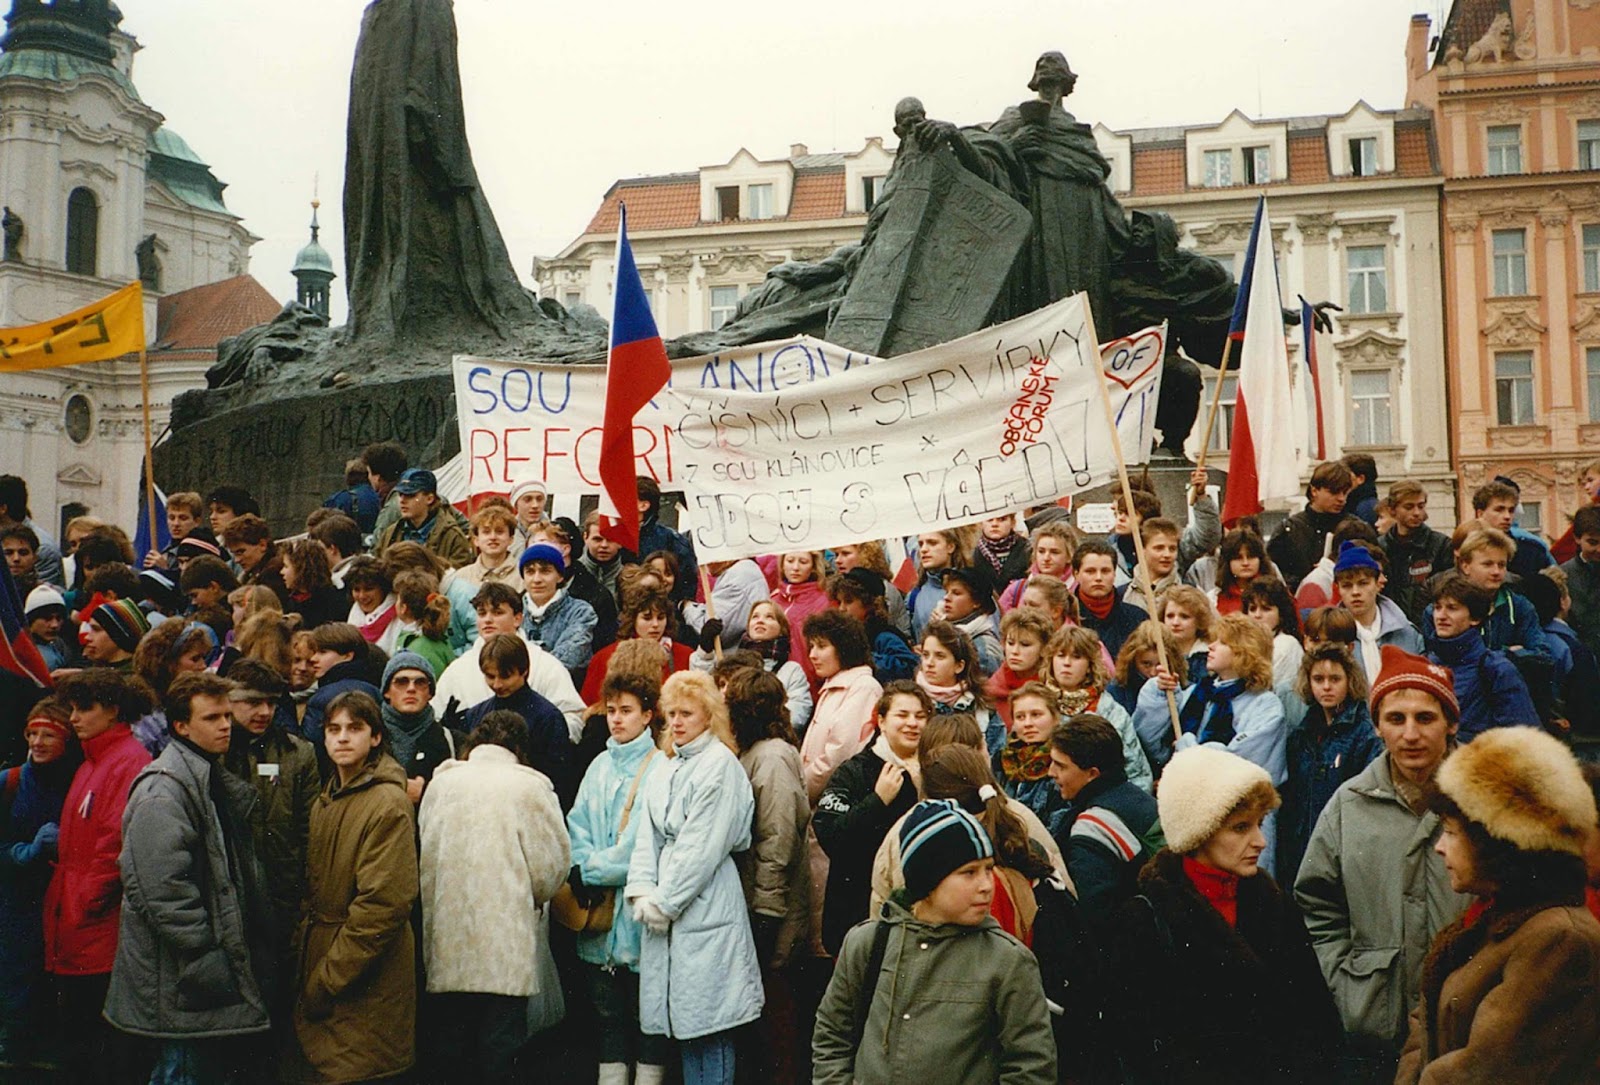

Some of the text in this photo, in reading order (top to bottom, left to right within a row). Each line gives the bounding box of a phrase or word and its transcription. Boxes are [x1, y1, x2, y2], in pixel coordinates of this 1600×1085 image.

[1112, 346, 1150, 371] OF
[468, 367, 571, 414] SOU
[678, 396, 833, 449] ČÍŠNÍCI
[871, 322, 1085, 426] SERVÍRKY
[766, 444, 885, 478] KLÁNOVICE
[696, 488, 812, 549] JDOU
[839, 481, 878, 534] S
